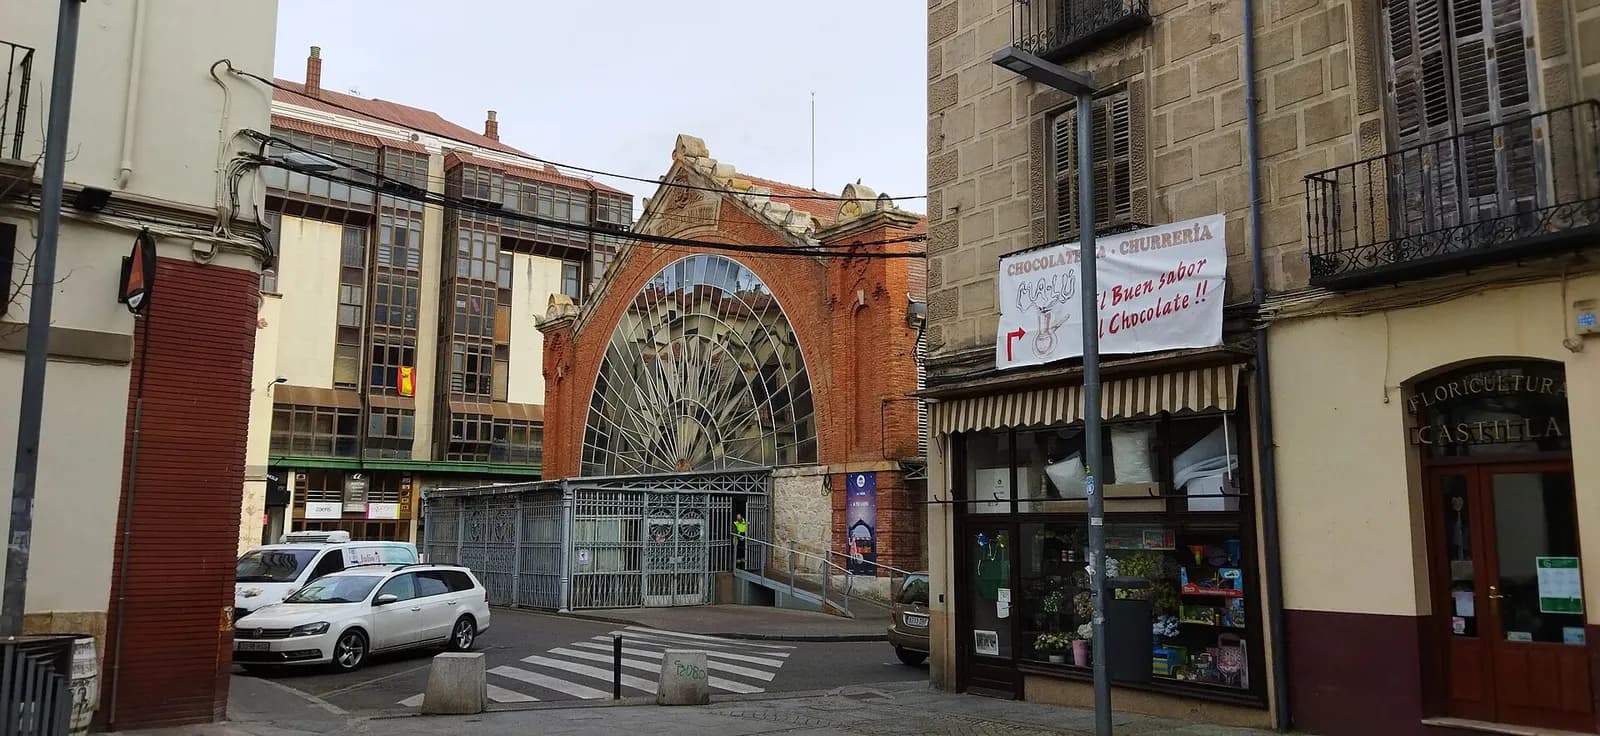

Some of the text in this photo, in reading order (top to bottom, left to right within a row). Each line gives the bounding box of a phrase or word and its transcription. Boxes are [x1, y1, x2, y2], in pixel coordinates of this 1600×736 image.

[1007, 222, 1213, 277] CHOCOLATEA CHURRERÍA
[1111, 278, 1153, 307] Buen
[1158, 258, 1207, 289] sabor
[1108, 292, 1189, 335] Chocolate
[1418, 415, 1563, 446] CASTILLA
